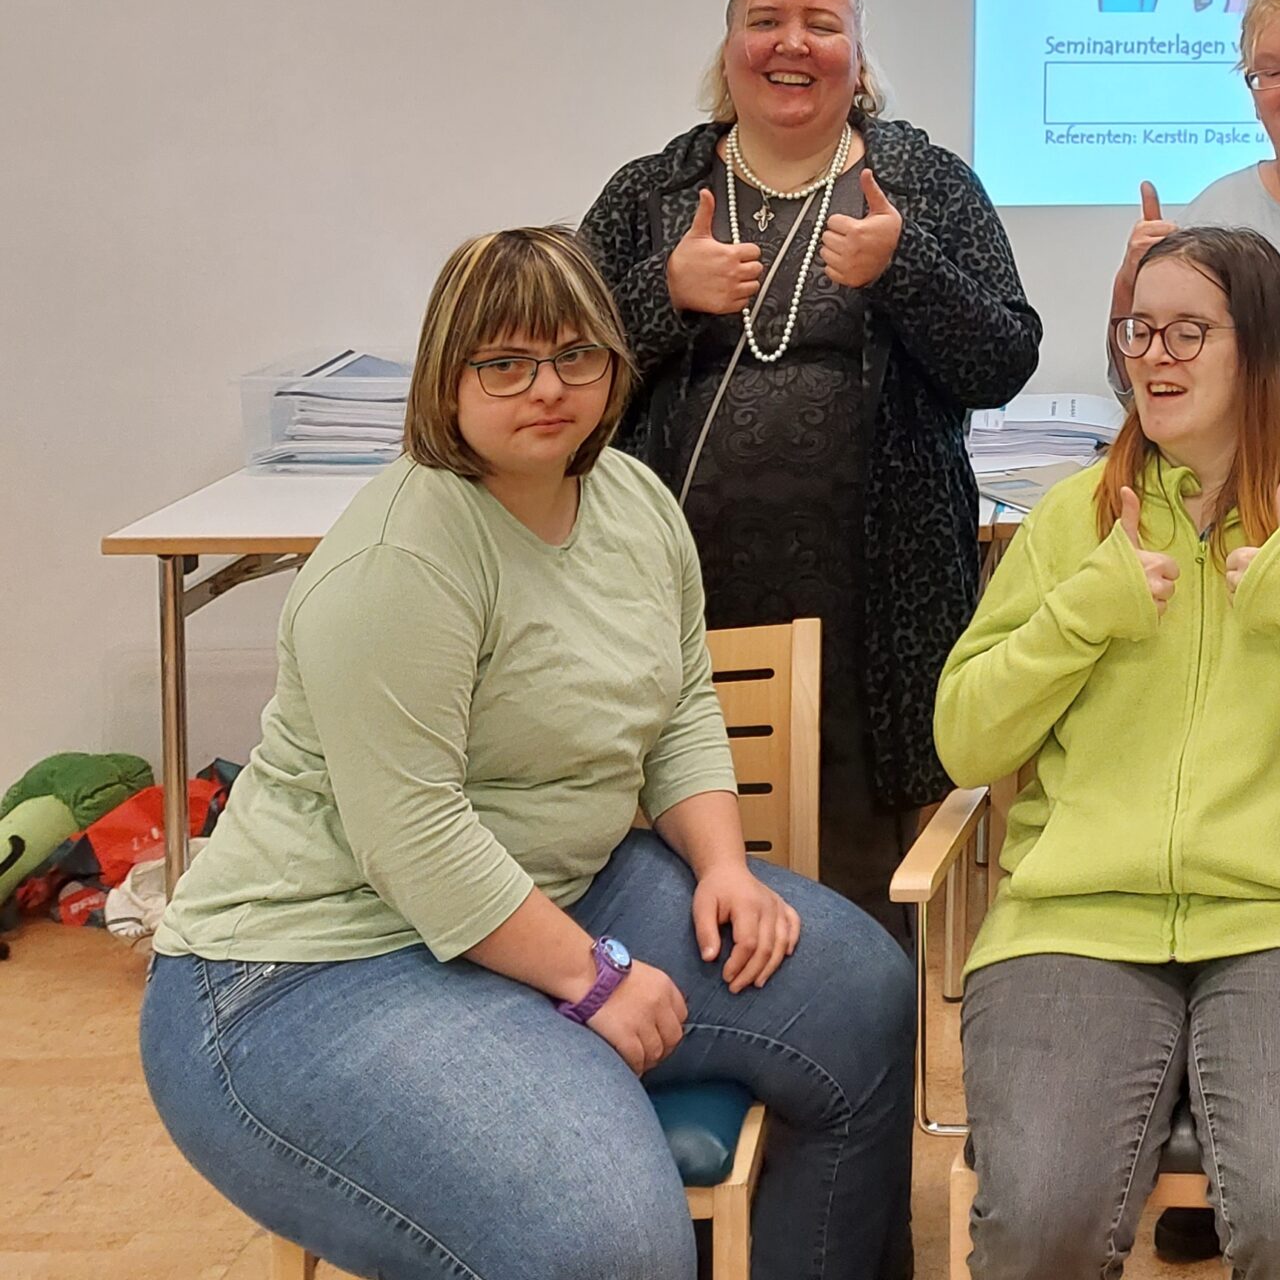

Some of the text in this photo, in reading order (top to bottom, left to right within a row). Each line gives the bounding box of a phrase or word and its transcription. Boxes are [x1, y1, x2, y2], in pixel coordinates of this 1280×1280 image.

[1045, 33, 1225, 60] Seminarunterlagen
[1044, 125, 1138, 146] Referenten:
[1143, 128, 1199, 145] Kerstin
[1205, 127, 1250, 145] Daske
